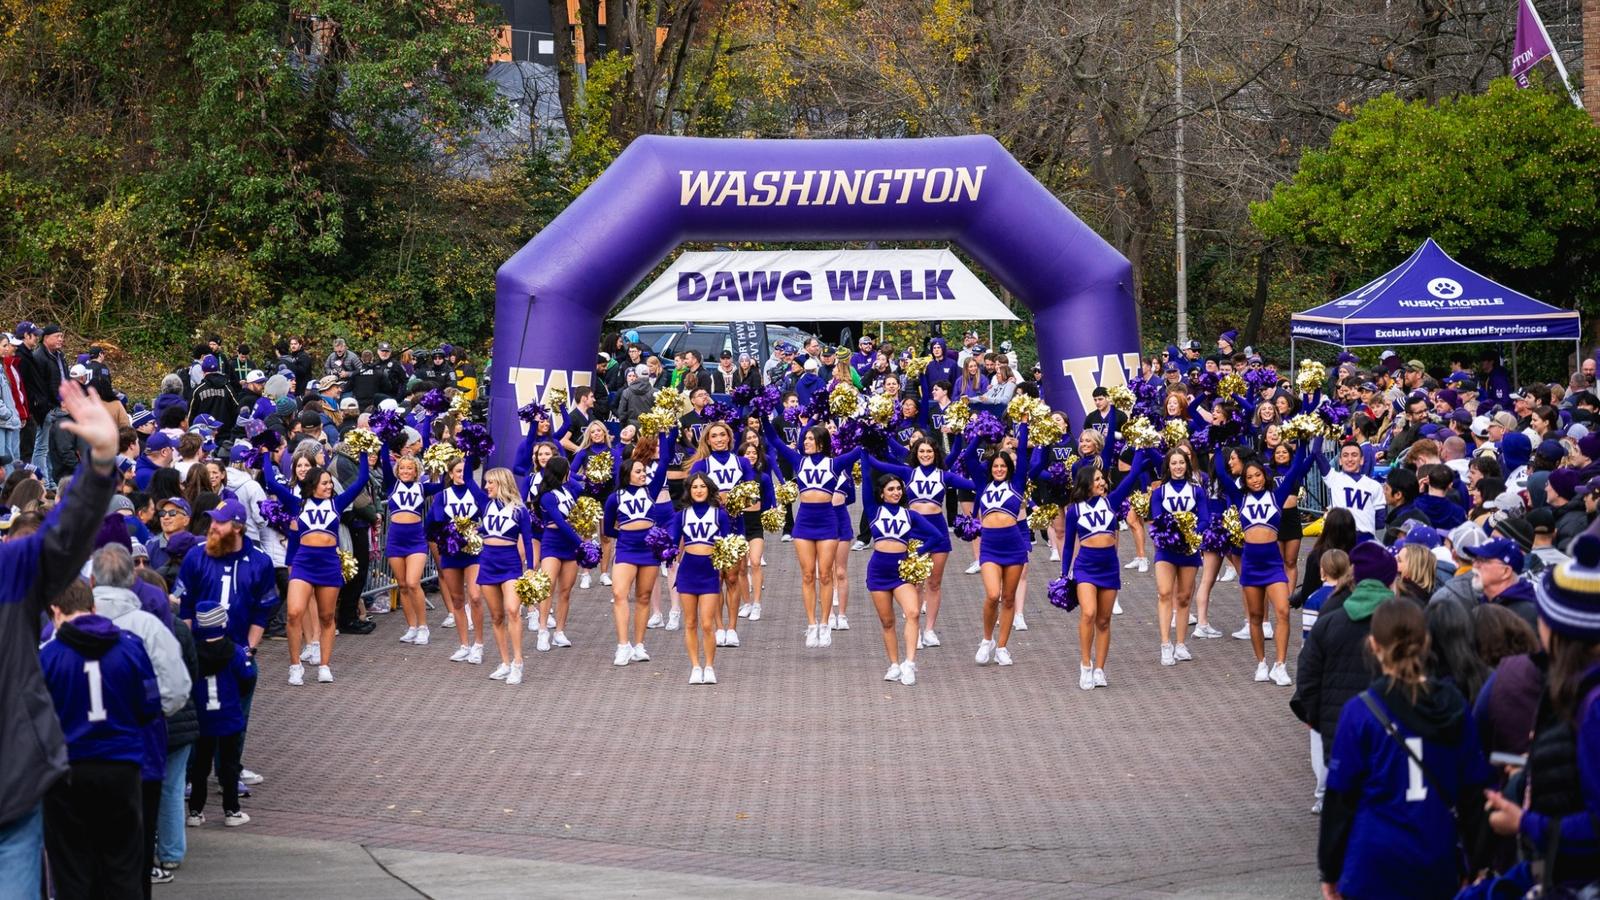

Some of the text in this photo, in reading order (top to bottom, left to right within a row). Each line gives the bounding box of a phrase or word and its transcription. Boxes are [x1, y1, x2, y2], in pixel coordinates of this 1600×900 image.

[679, 165, 987, 206] WASHINGTON
[677, 269, 956, 302] DAWG WALK
[1398, 297, 1505, 307] HUSKY MOBILE
[1375, 324, 1548, 338] Exclusive VIP Perks and Experiences
[1053, 447, 1072, 460] W
[714, 468, 736, 484] W
[803, 468, 827, 484] W
[915, 480, 938, 495] W
[985, 488, 1005, 503] W
[398, 490, 419, 507] W
[624, 498, 646, 514] W
[1167, 496, 1191, 512] W
[1343, 487, 1372, 510] W
[306, 509, 329, 525] W
[449, 502, 473, 518] W
[1084, 509, 1107, 527] W
[1246, 503, 1272, 519] W
[487, 513, 509, 531] W
[688, 522, 713, 538] W
[881, 518, 905, 535] W
[220, 575, 232, 609] 1
[83, 660, 107, 722] 1
[204, 675, 221, 710] 1
[1405, 737, 1428, 802] 1
